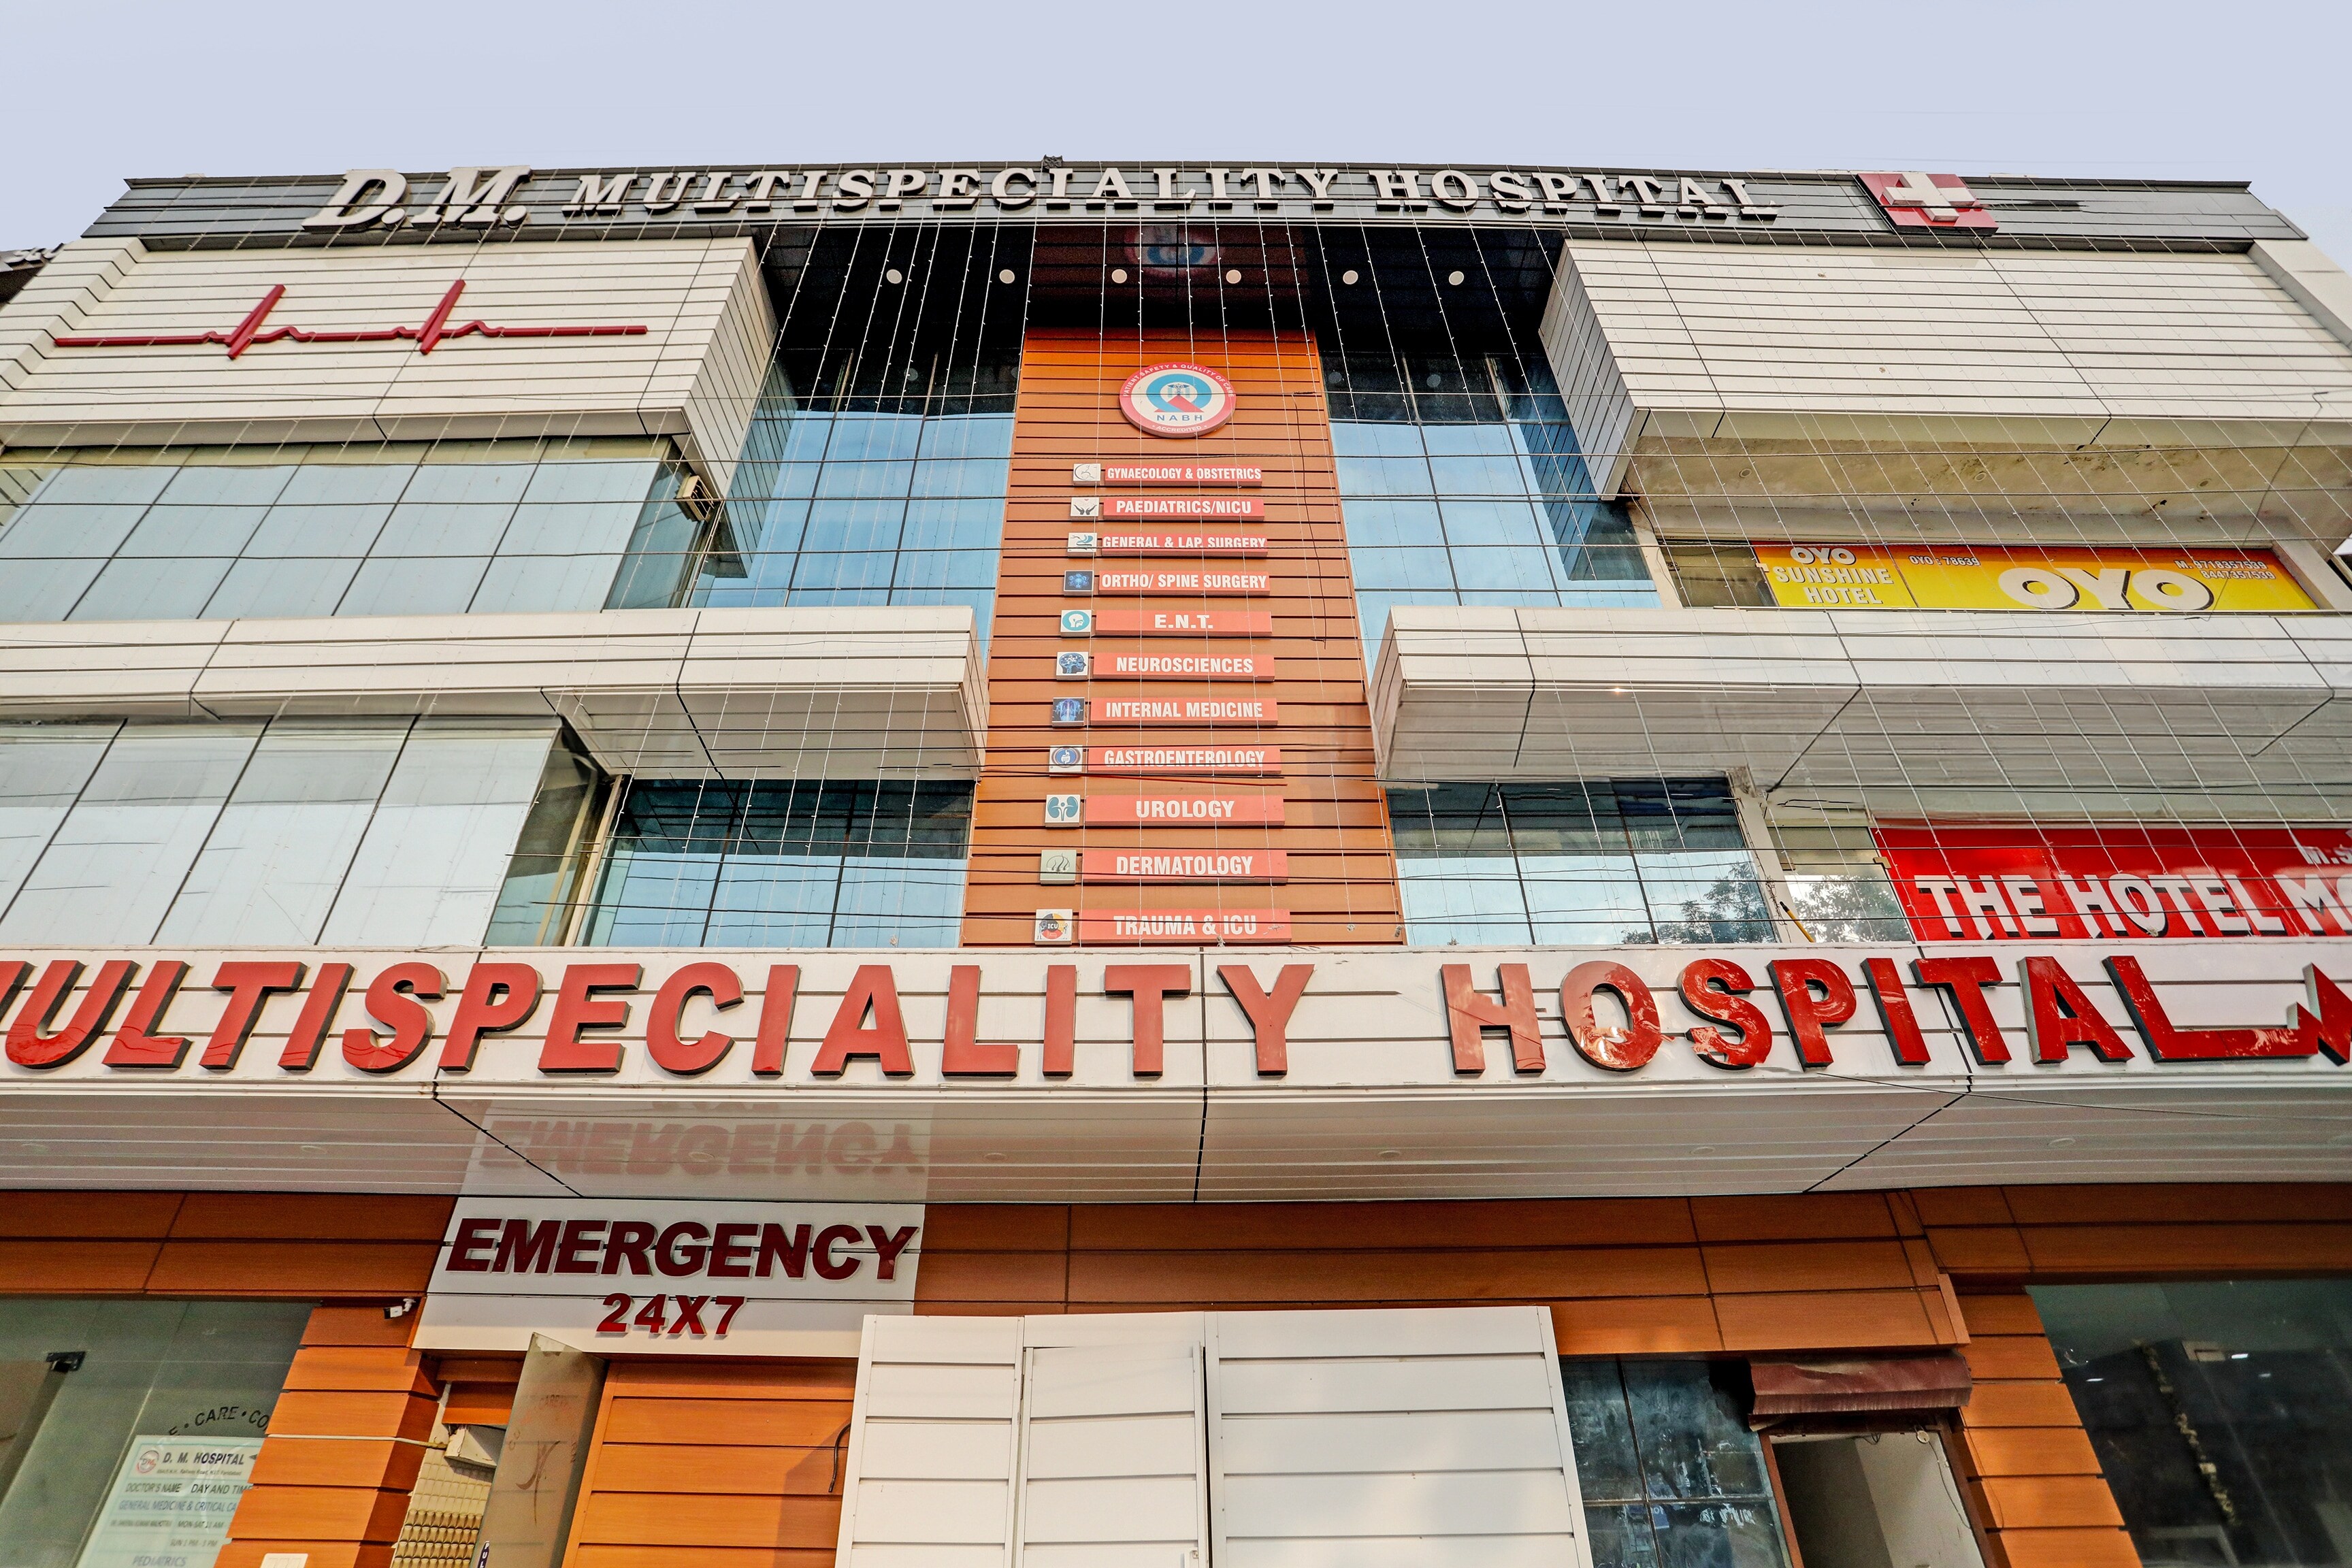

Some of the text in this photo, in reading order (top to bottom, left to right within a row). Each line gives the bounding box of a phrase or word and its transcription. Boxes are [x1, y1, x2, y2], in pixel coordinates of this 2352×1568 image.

[561, 167, 1339, 217] MULTISPECIALITY
[1368, 169, 1778, 221] HOSPITAL
[1123, 375, 1140, 397] PATIENT
[1139, 364, 1170, 376] SAFETY
[1180, 363, 1216, 376] QUALITY
[1223, 382, 1235, 397] CARE
[1107, 467, 1262, 480] GYNAECOLOGY & OBSTETRICS
[1116, 500, 1252, 515] PAEDIATRICS/NICU
[1102, 536, 1267, 549] GENERAL & LAP. SURGERY
[1789, 546, 1857, 566] OYO
[1908, 555, 1934, 565] OYO
[1942, 556, 1981, 566] 78639
[2174, 559, 2268, 570] M. 9718357539
[1101, 574, 1267, 589] ORTHO/ SPINE SURGERY
[1776, 566, 1895, 585] SUNSHINE
[2200, 570, 2276, 579] 8447357539
[1804, 587, 1884, 605] HOTEL
[1997, 567, 2215, 611] OYO
[1154, 614, 1213, 629] E.N.T.
[1116, 657, 1254, 673] NEUROSCIENCES
[1106, 702, 1263, 718] INTERNAL MEDICINE
[1104, 749, 1265, 768] GASTROENTEROLOGY
[1136, 800, 1235, 819] UROLOGY
[1116, 855, 1253, 875] DERMATOLOGY
[1914, 875, 2060, 938] THE
[2057, 873, 2285, 938] HOTEL
[1113, 914, 1257, 935] TRAUMA & ICU
[1440, 954, 2317, 1074] HOSPITAL
[445, 1217, 920, 1281] EMERGENCY
[595, 1292, 748, 1339] 24X7
[195, 1406, 240, 1426] CARE
[163, 1452, 245, 1465] D. M. HOSPITAL
[125, 1482, 161, 1492] DOCTOR'S
[161, 1483, 182, 1492] NAME
[191, 1484, 210, 1494] DAY
[211, 1484, 231, 1494] AND
[118, 1499, 150, 1510] GENERAL
[152, 1499, 186, 1511] MEDICINE
[194, 1501, 225, 1512] CRITICAL
[132, 1555, 187, 1567] PEDIATRICS
